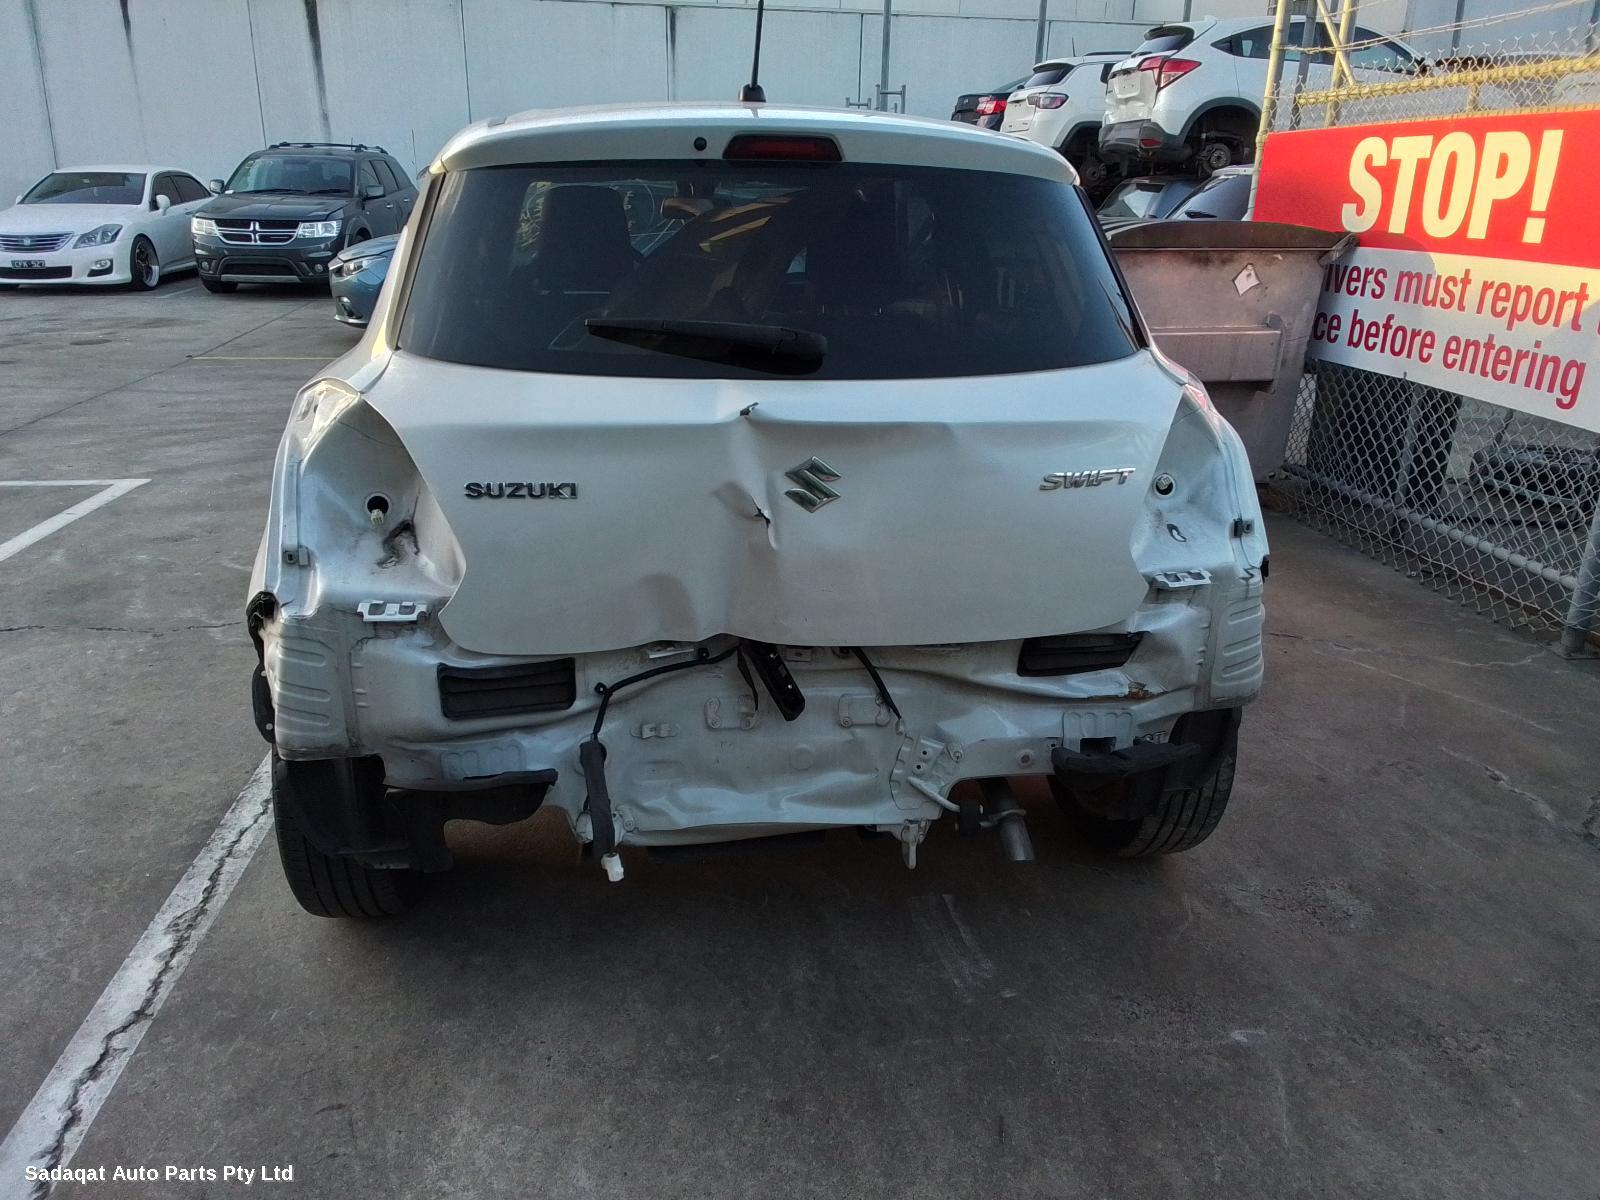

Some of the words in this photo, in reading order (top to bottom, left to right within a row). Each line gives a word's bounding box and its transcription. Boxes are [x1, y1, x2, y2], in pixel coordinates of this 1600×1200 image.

[1342, 129, 1564, 244] STOP!
[1394, 268, 1472, 312] must
[1476, 282, 1590, 332] report
[1312, 311, 1342, 344] ce
[1347, 309, 1436, 364] before
[1442, 334, 1586, 410] entering
[464, 481, 578, 500] SUZUKI
[1039, 467, 1136, 491] SWIFT
